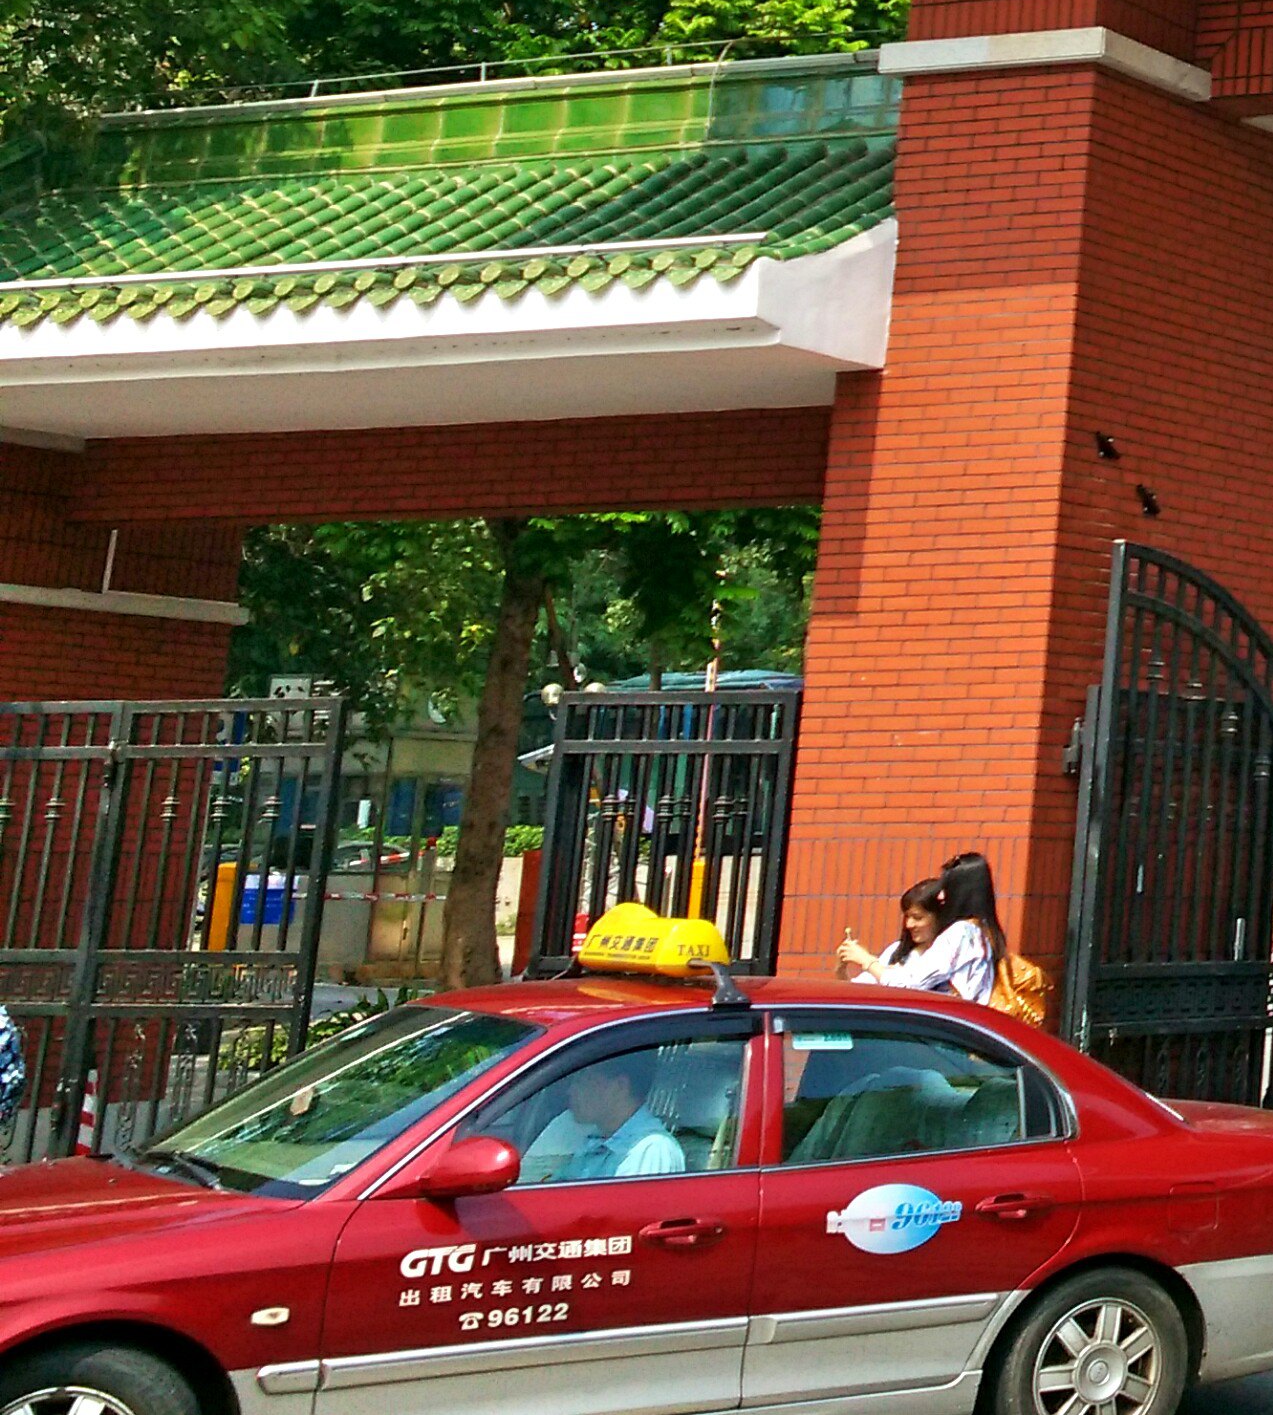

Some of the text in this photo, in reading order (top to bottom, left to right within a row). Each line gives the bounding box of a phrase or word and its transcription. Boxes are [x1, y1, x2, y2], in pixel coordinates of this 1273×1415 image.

[588, 934, 659, 953] 广州交通集团
[677, 944, 710, 957] TAXI
[400, 1235, 633, 1278] GTG 广州交通集团
[399, 1270, 632, 1307] 出租汽车有限公司
[487, 1303, 569, 1328] 96122
